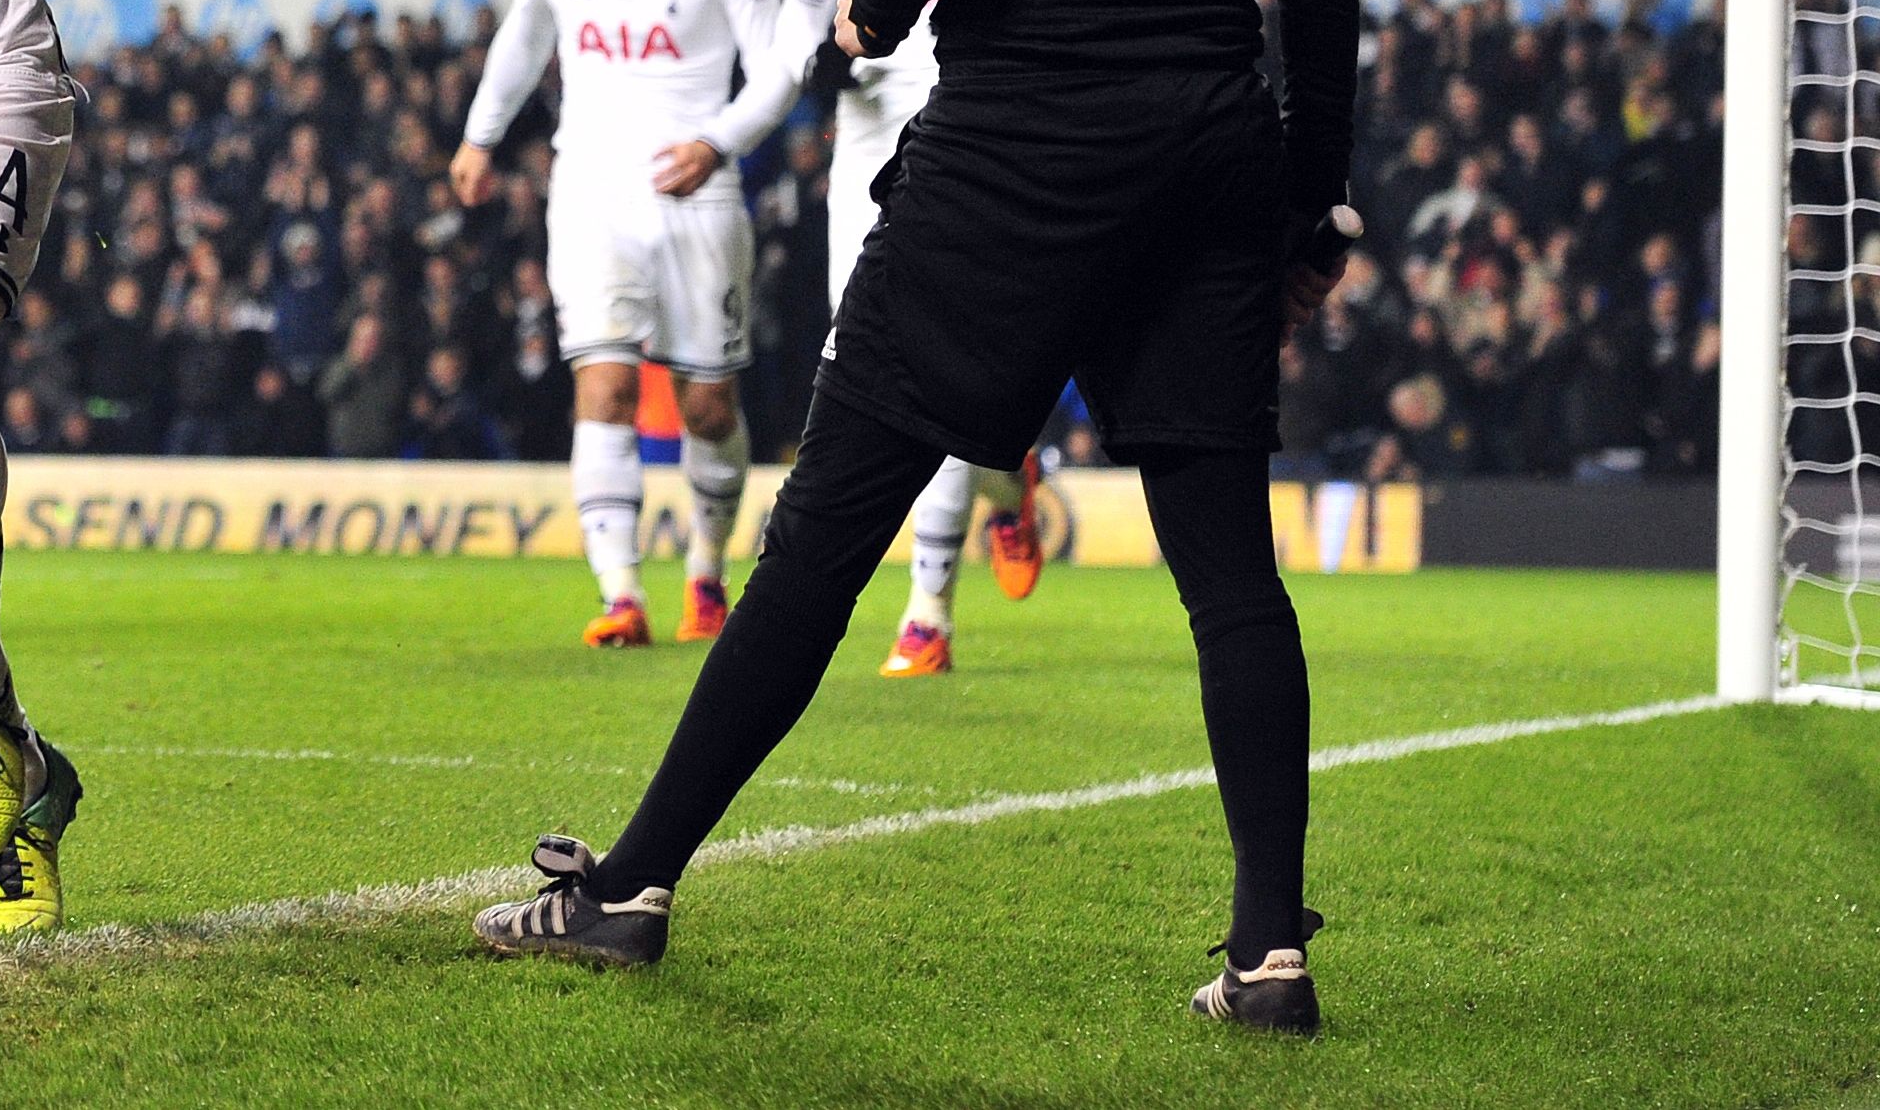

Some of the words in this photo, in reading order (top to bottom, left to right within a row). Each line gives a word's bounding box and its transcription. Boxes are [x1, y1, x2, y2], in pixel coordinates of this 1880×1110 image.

[577, 21, 682, 62] AIA
[24, 494, 226, 550] SEND
[258, 498, 560, 557] MONEY
